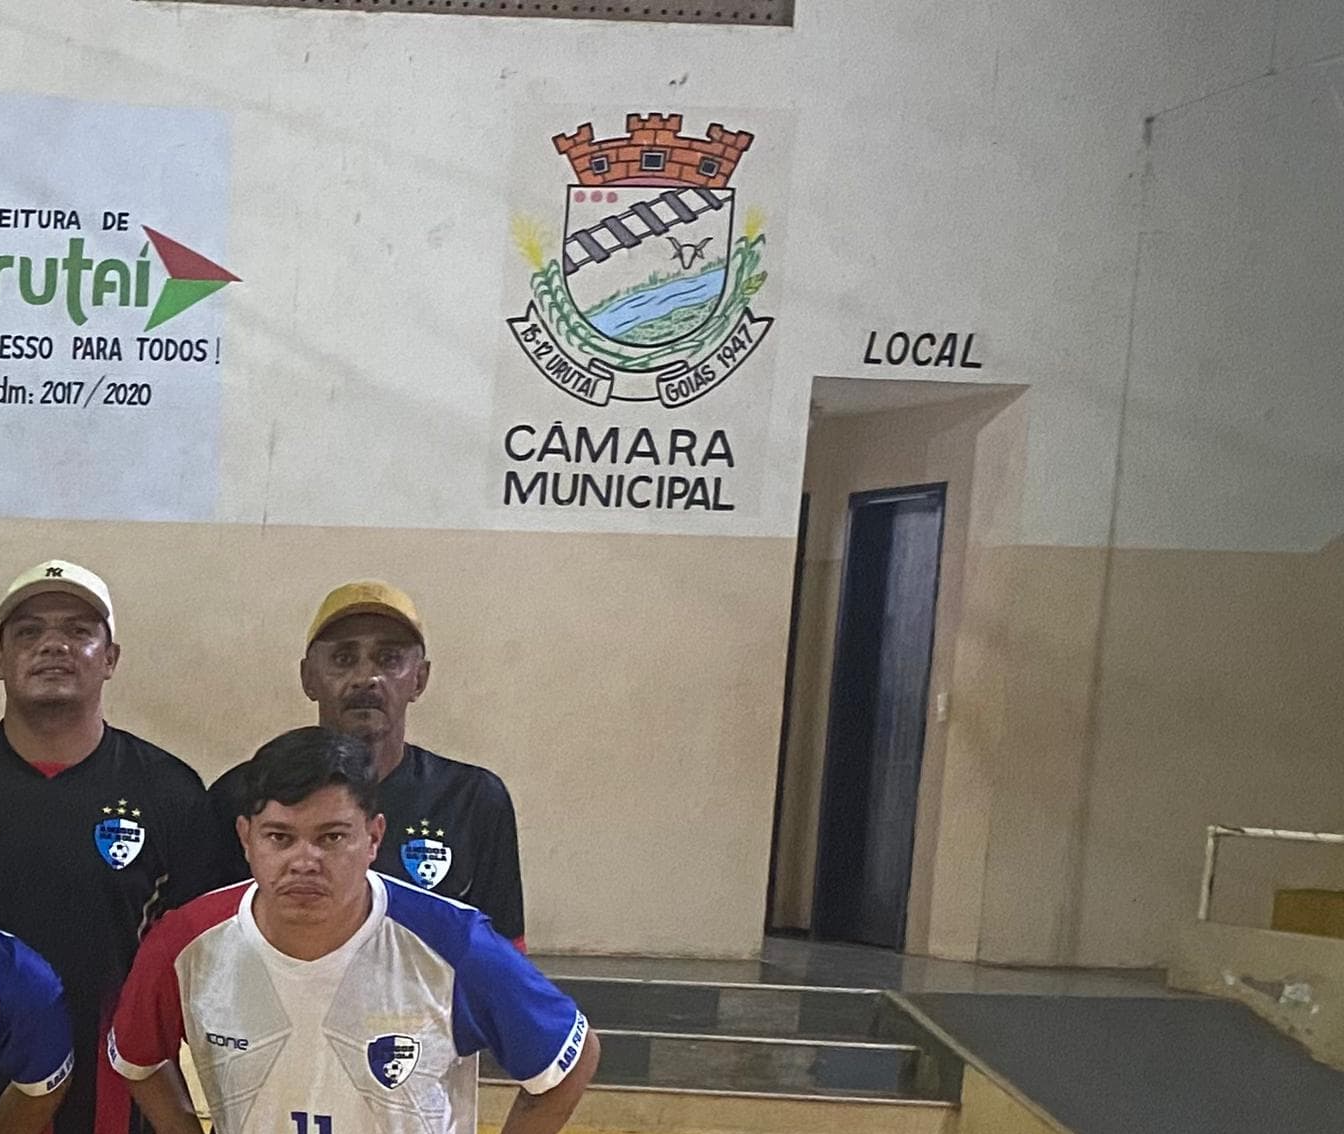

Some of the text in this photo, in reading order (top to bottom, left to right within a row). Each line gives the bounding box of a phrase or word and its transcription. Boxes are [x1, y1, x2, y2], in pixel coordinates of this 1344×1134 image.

[102, 211, 130, 231] DE
[72, 337, 122, 362] PARA
[716, 323, 755, 369] 1947
[863, 330, 984, 369] LOCAL
[40, 375, 152, 409] 2017/2020
[503, 420, 735, 468] CÂMARA
[502, 470, 735, 511] MUNICIPAL
